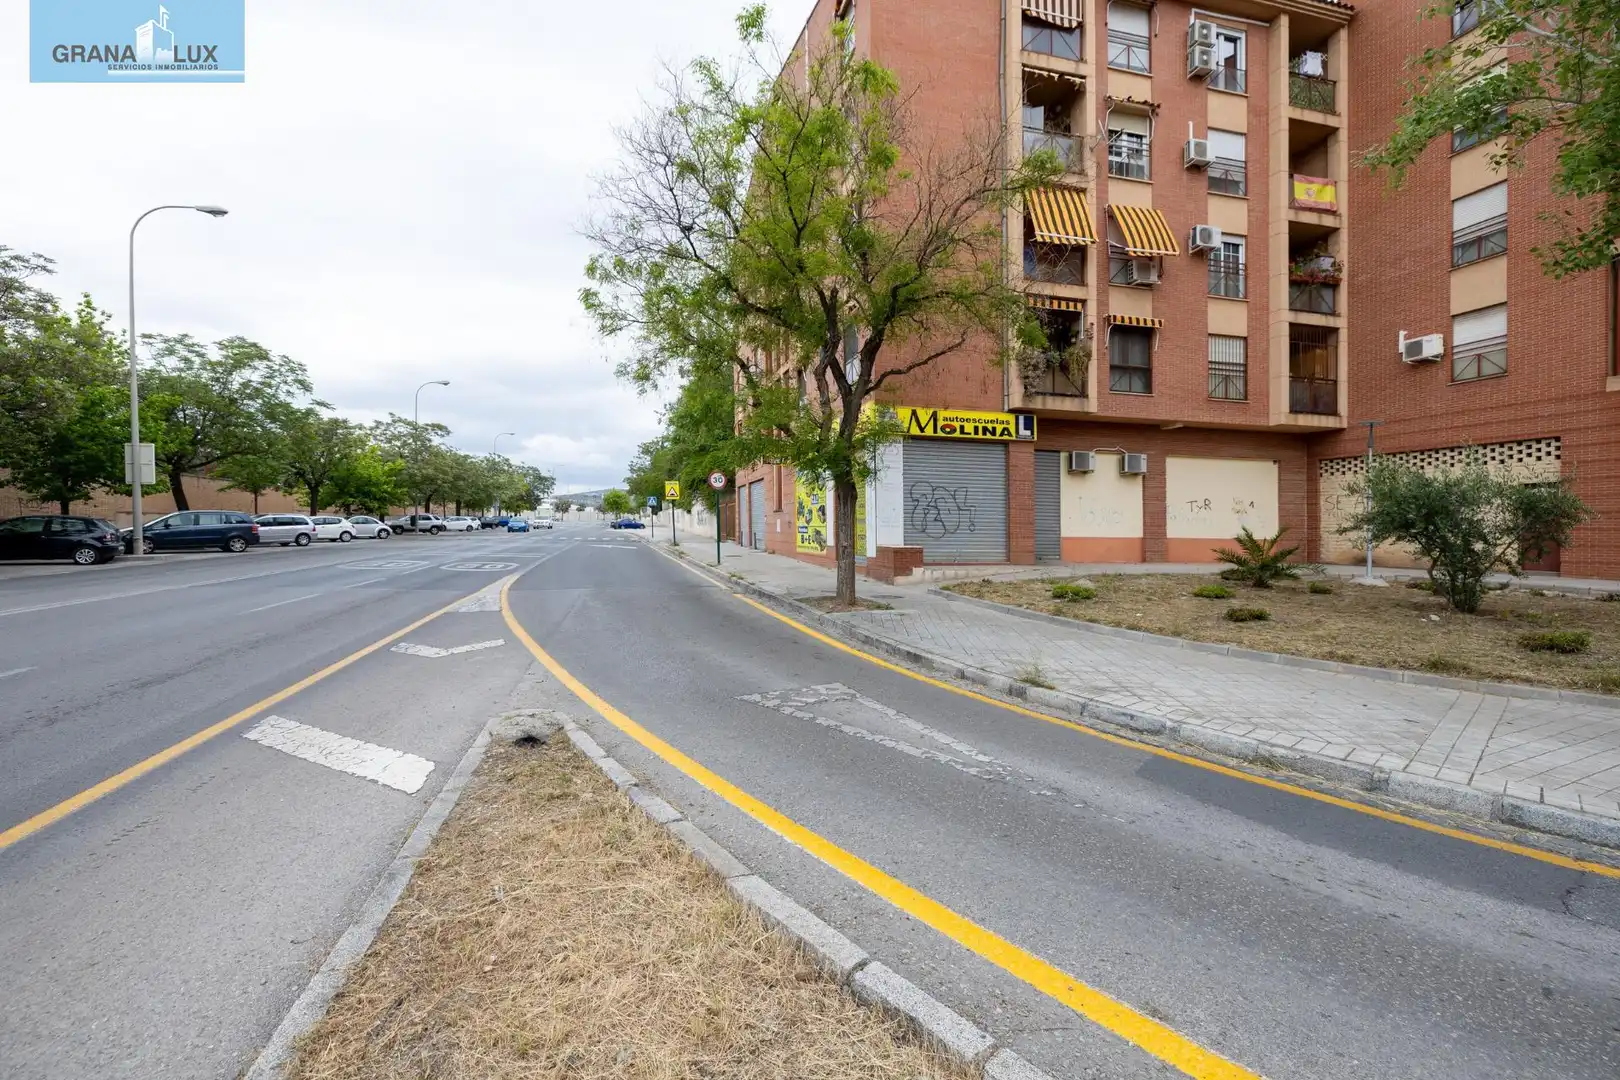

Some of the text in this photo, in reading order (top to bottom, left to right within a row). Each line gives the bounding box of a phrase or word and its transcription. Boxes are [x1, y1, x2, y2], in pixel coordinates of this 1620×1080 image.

[906, 408, 1014, 438] MOLINA
[942, 415, 1011, 425] autoescuelas
[1019, 415, 1031, 437] L
[712, 476, 723, 484] 30
